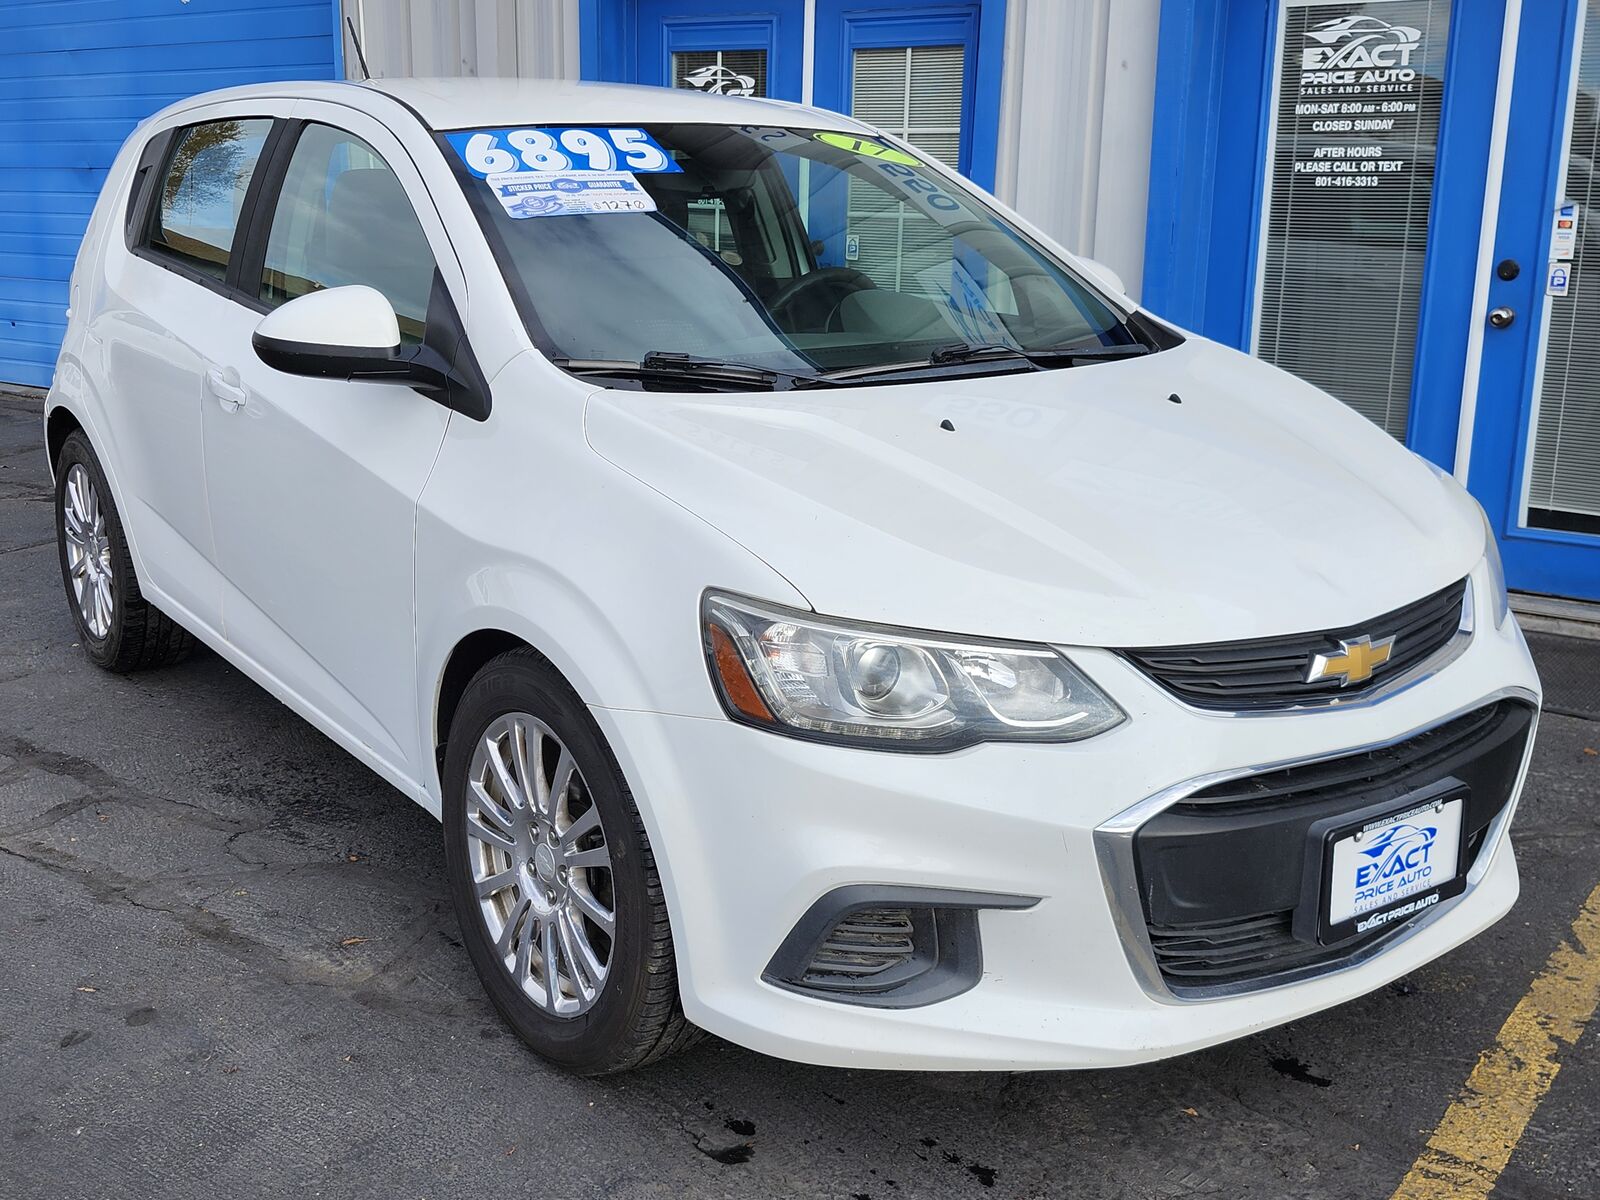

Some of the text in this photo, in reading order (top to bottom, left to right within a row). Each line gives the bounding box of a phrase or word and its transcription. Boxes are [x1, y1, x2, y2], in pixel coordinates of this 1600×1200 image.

[1301, 42, 1420, 70] EXACT
[1300, 68, 1416, 85] PRICE AUTO
[1300, 84, 1415, 95] SALES AND SERVICE
[1295, 103, 1340, 115] MON-SAT
[1381, 101, 1403, 112] 6:00
[1403, 103, 1417, 112] PM
[1312, 119, 1395, 132] CLOSED SUNDAY
[465, 129, 668, 173] 6895
[1313, 146, 1383, 158] AFTER HOURS
[1294, 161, 1404, 172] PLEASE CALL OR TEXT
[507, 184, 534, 193] STICKER
[534, 182, 553, 191] PRICE
[1355, 841, 1435, 889] EXACT
[1354, 865, 1433, 903] PRICE AUTO
[1353, 879, 1432, 914] SALES AND SERVICE
[1357, 893, 1440, 933] EXACT PRICE AUTO
